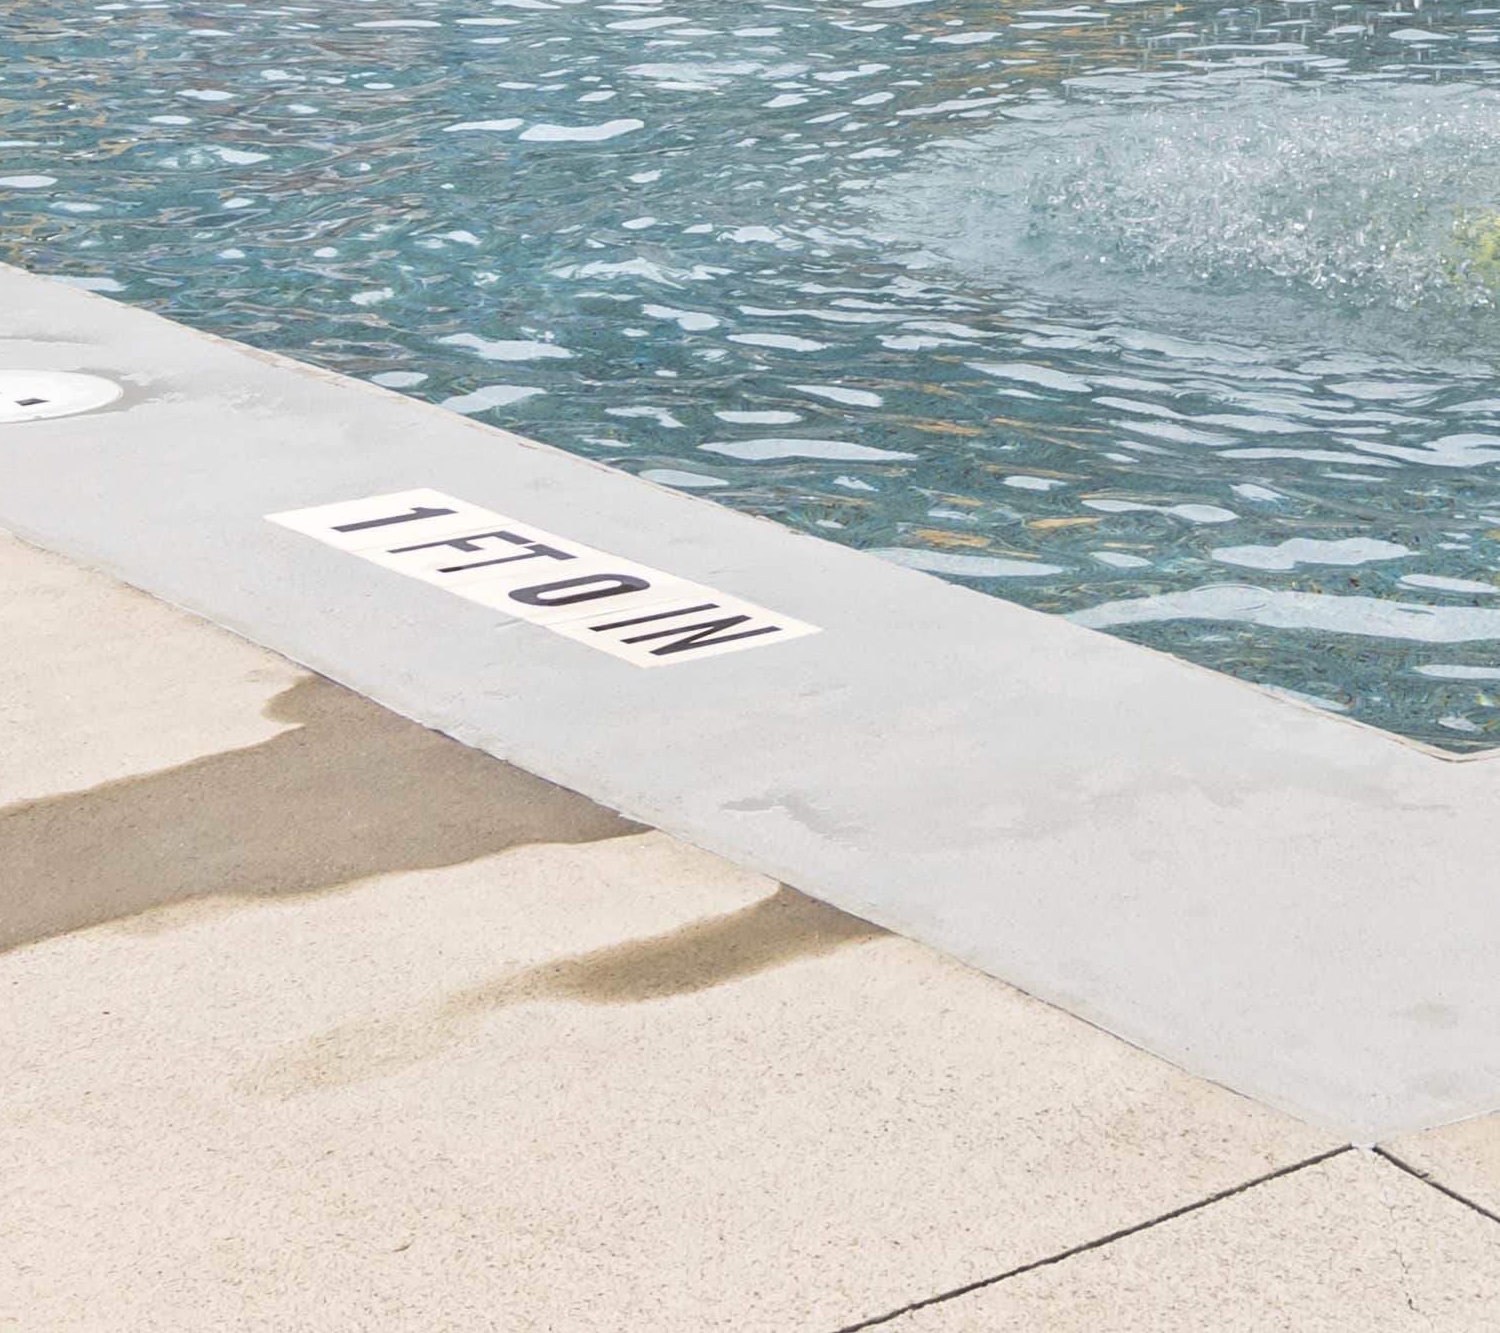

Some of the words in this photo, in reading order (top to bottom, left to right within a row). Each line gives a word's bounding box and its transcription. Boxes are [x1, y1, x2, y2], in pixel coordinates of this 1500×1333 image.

[330, 505, 459, 533] 1
[386, 528, 578, 574] FT
[587, 602, 783, 656] IN
